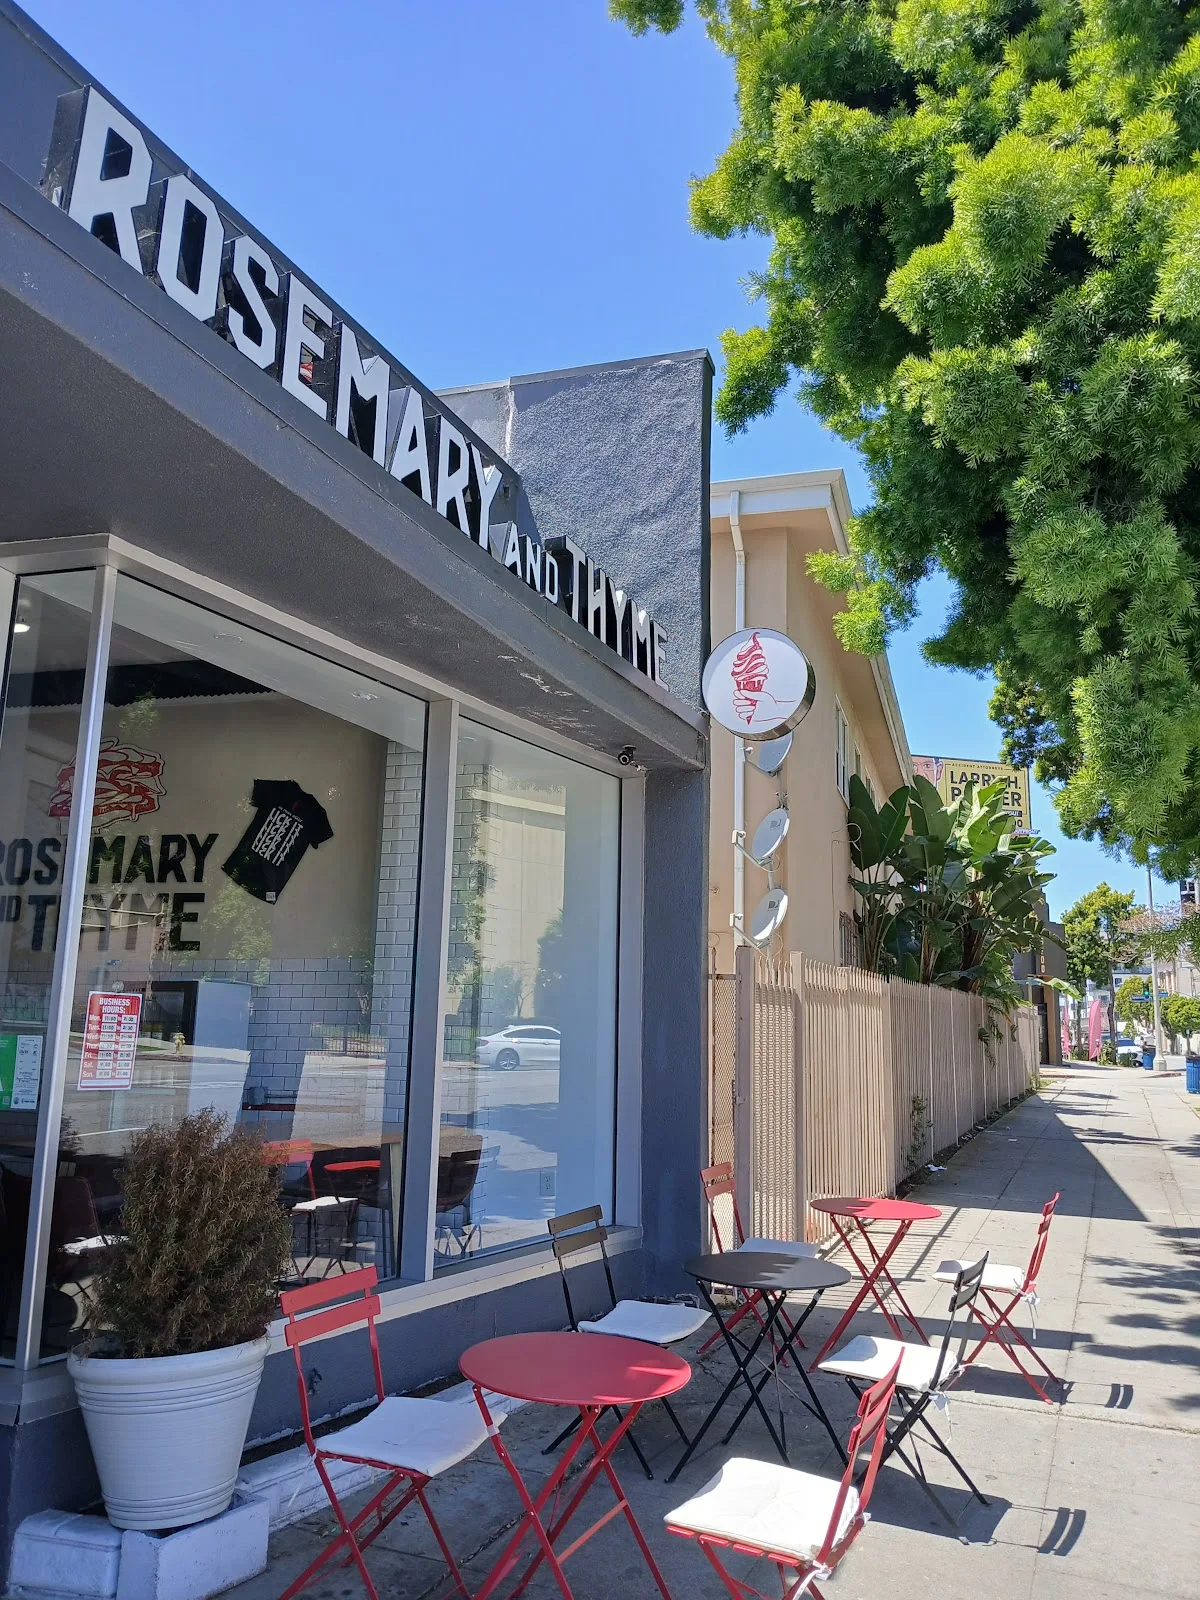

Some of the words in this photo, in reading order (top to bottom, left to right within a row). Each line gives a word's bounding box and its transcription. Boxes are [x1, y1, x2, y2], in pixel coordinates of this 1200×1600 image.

[67, 85, 502, 551] ROSEMARY
[504, 521, 559, 604] AND
[564, 535, 670, 692] THYME
[951, 787, 1021, 807] PER
[0, 834, 219, 885] OSMARY
[28, 892, 205, 952] TYME
[99, 997, 131, 1006] BUSINESS
[102, 1005, 126, 1014] HOURS:
